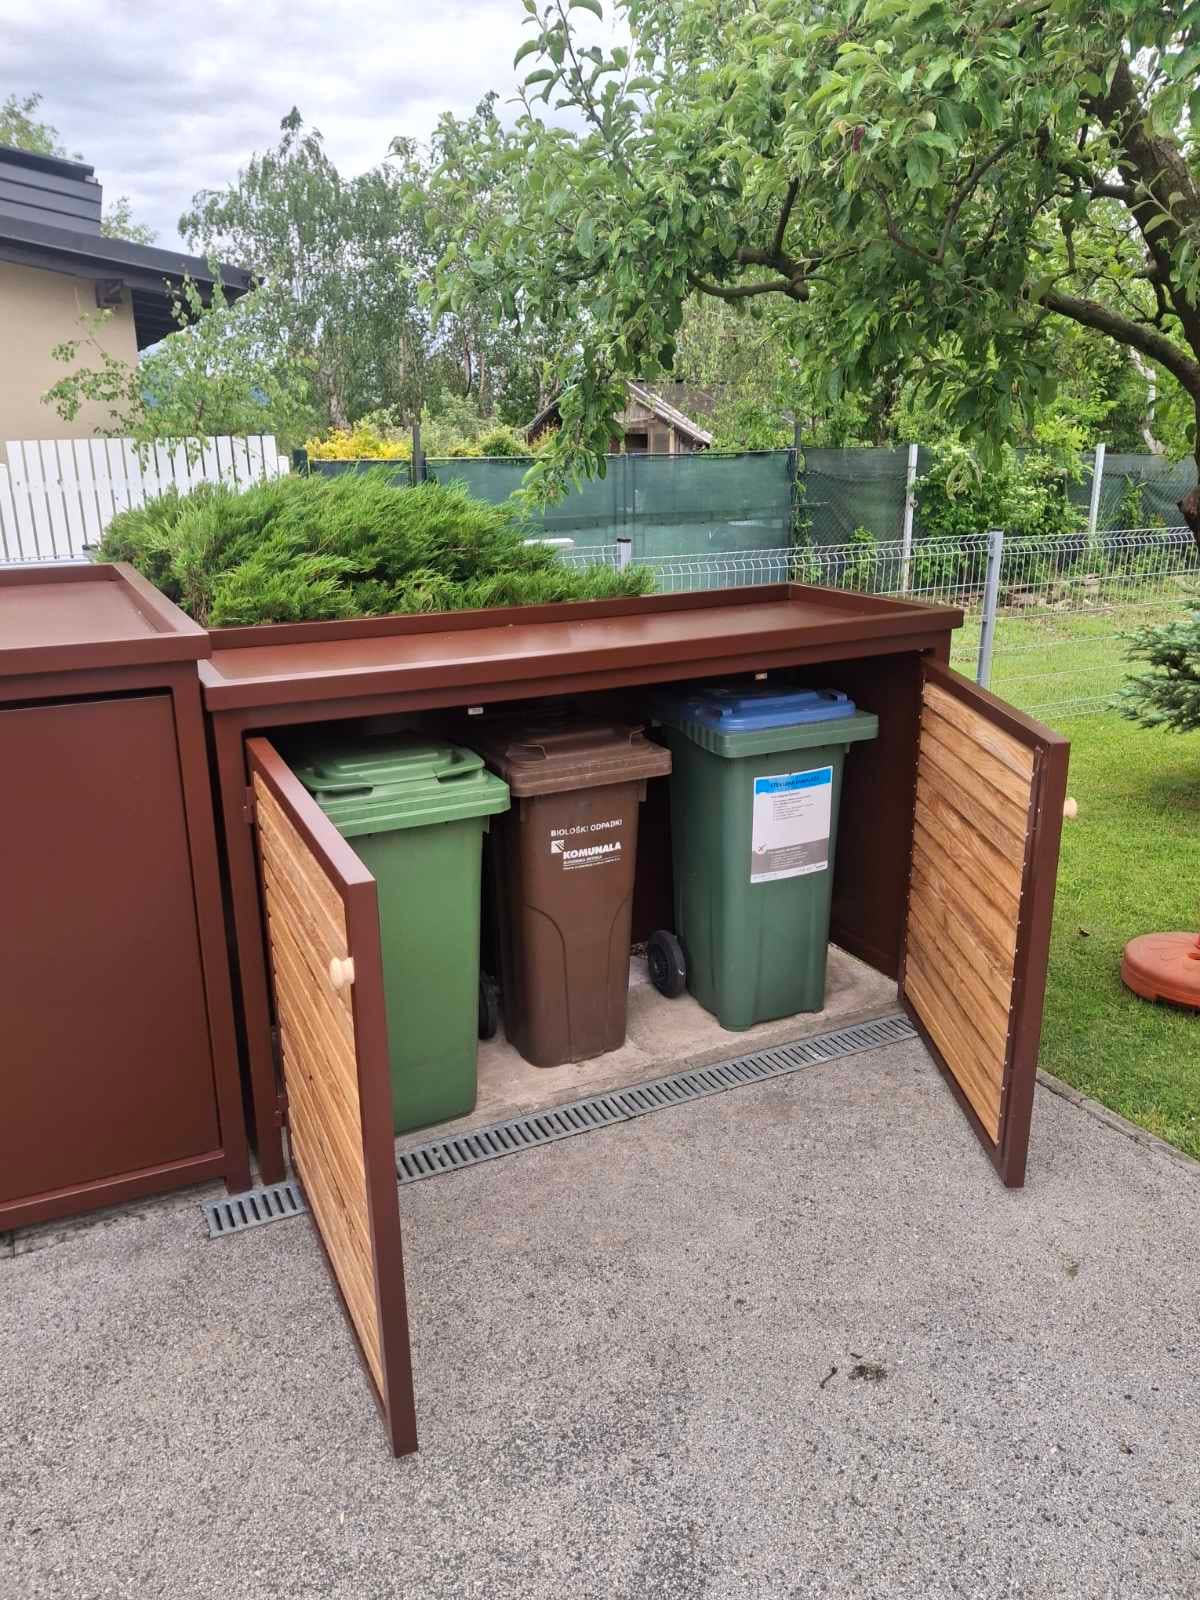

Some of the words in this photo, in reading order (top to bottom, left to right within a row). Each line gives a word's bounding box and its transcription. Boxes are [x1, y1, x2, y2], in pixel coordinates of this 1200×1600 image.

[550, 826, 589, 837] BIOLOŠKI
[590, 819, 623, 832] ODPADKI
[562, 841, 622, 860] KOMUNALA
